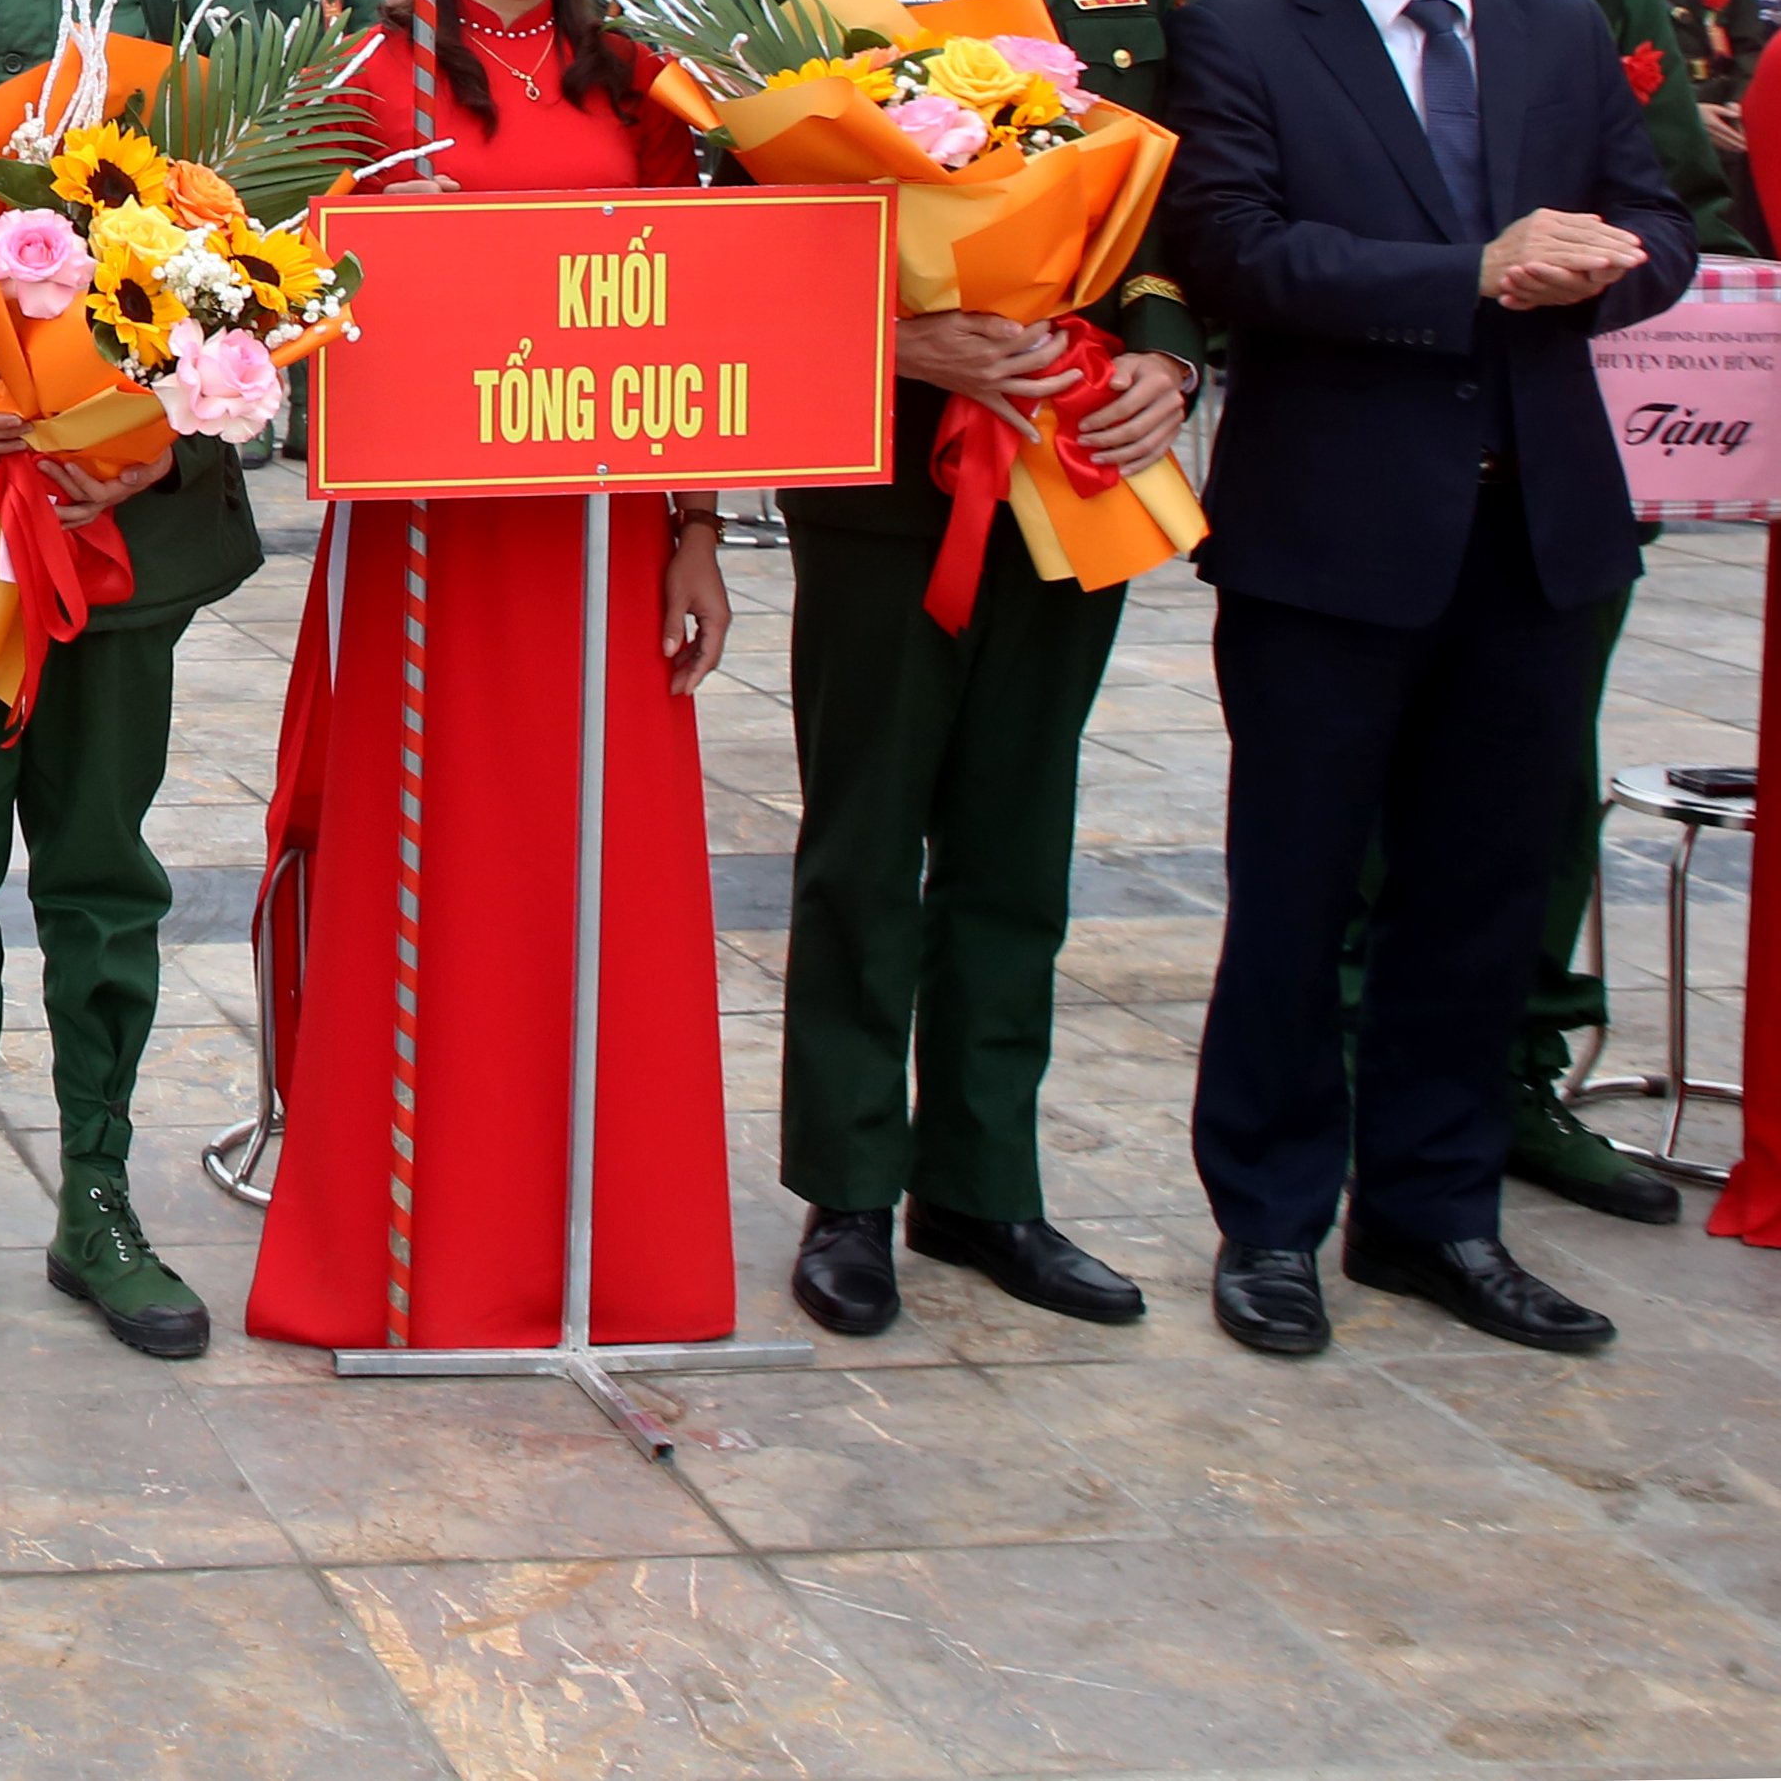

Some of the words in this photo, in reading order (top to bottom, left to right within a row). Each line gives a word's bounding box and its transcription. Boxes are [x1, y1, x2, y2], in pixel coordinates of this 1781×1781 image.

[559, 225, 667, 329] KHỐI
[472, 338, 596, 444] TỔNG
[610, 363, 704, 457] CỤC
[718, 362, 748, 437] II
[1624, 402, 1754, 457] Tặng
